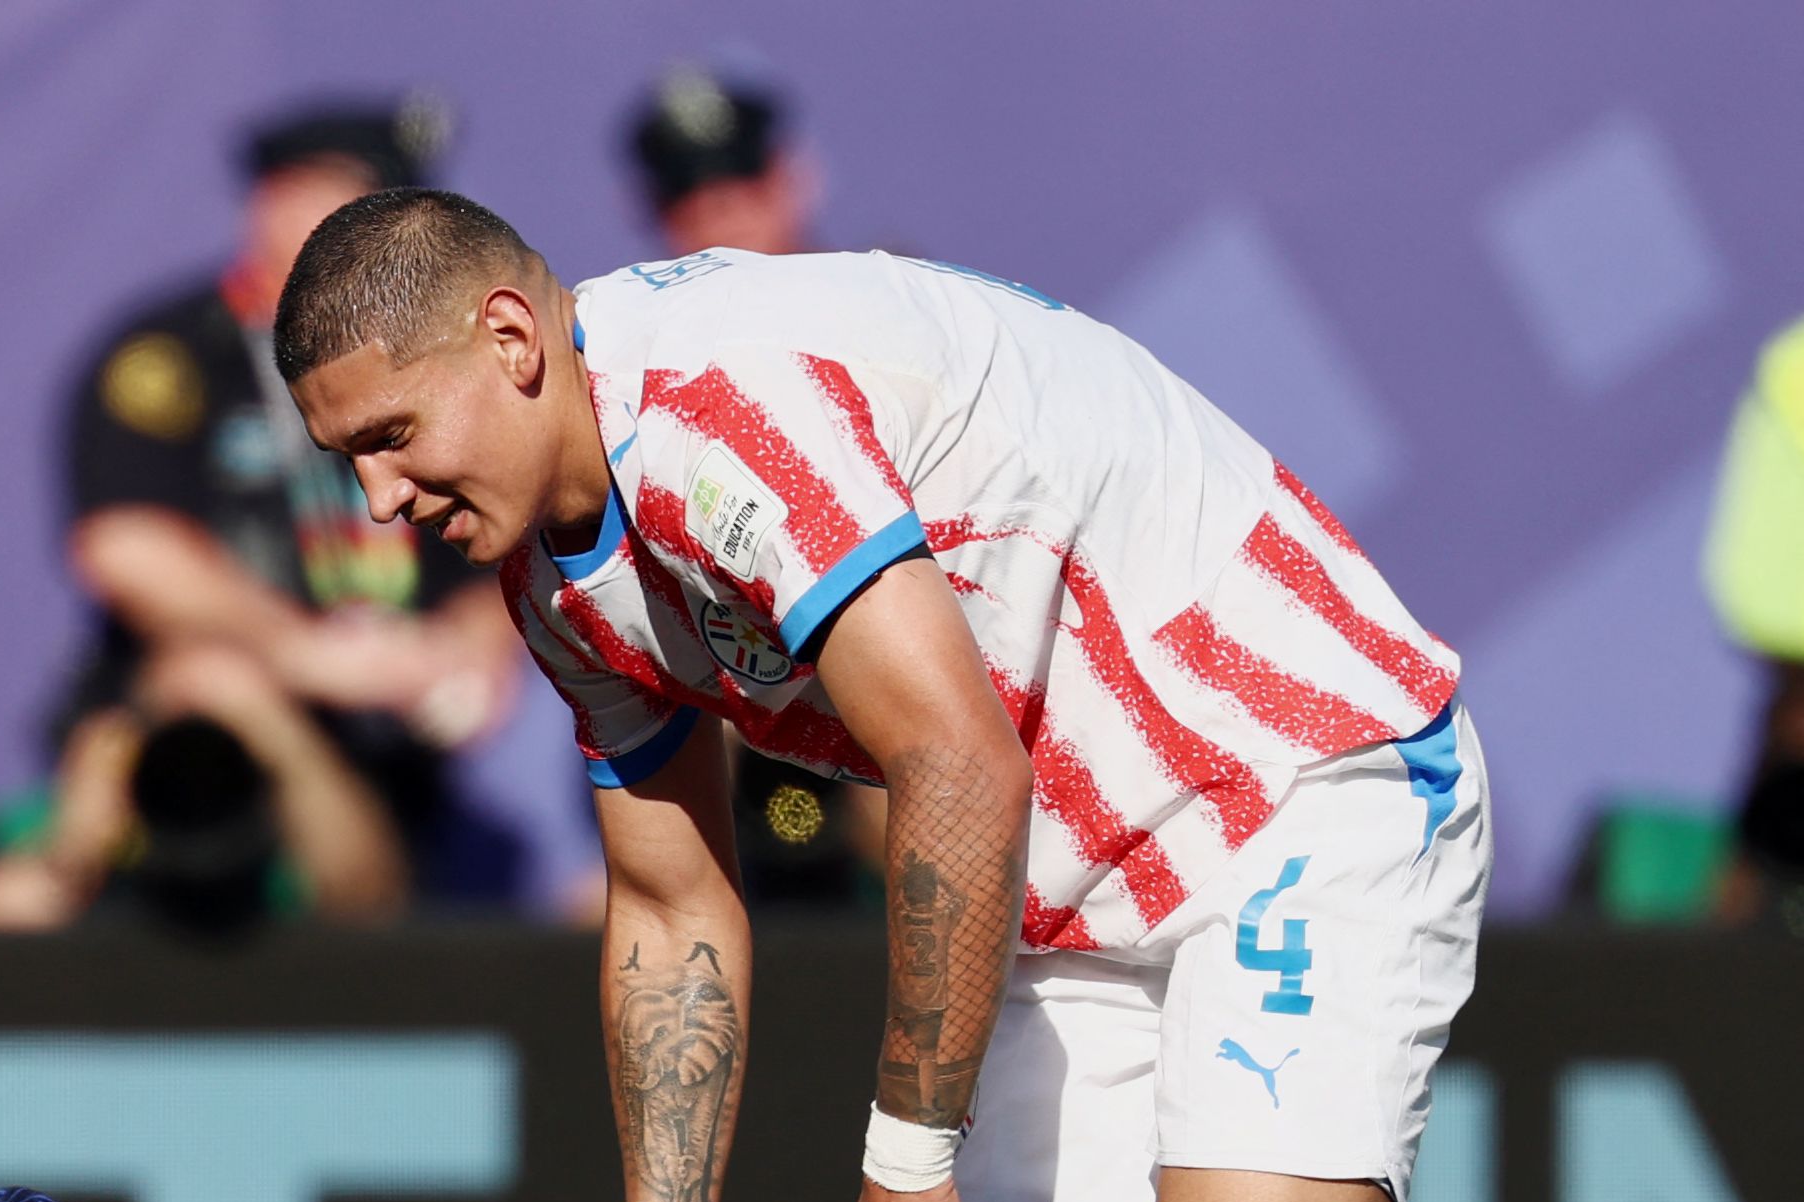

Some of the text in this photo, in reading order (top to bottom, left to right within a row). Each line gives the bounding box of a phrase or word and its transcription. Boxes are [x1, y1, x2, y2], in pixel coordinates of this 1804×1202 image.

[723, 498, 760, 559] EDUCATION
[742, 530, 756, 551] FIFA
[1235, 854, 1315, 1017] 4
